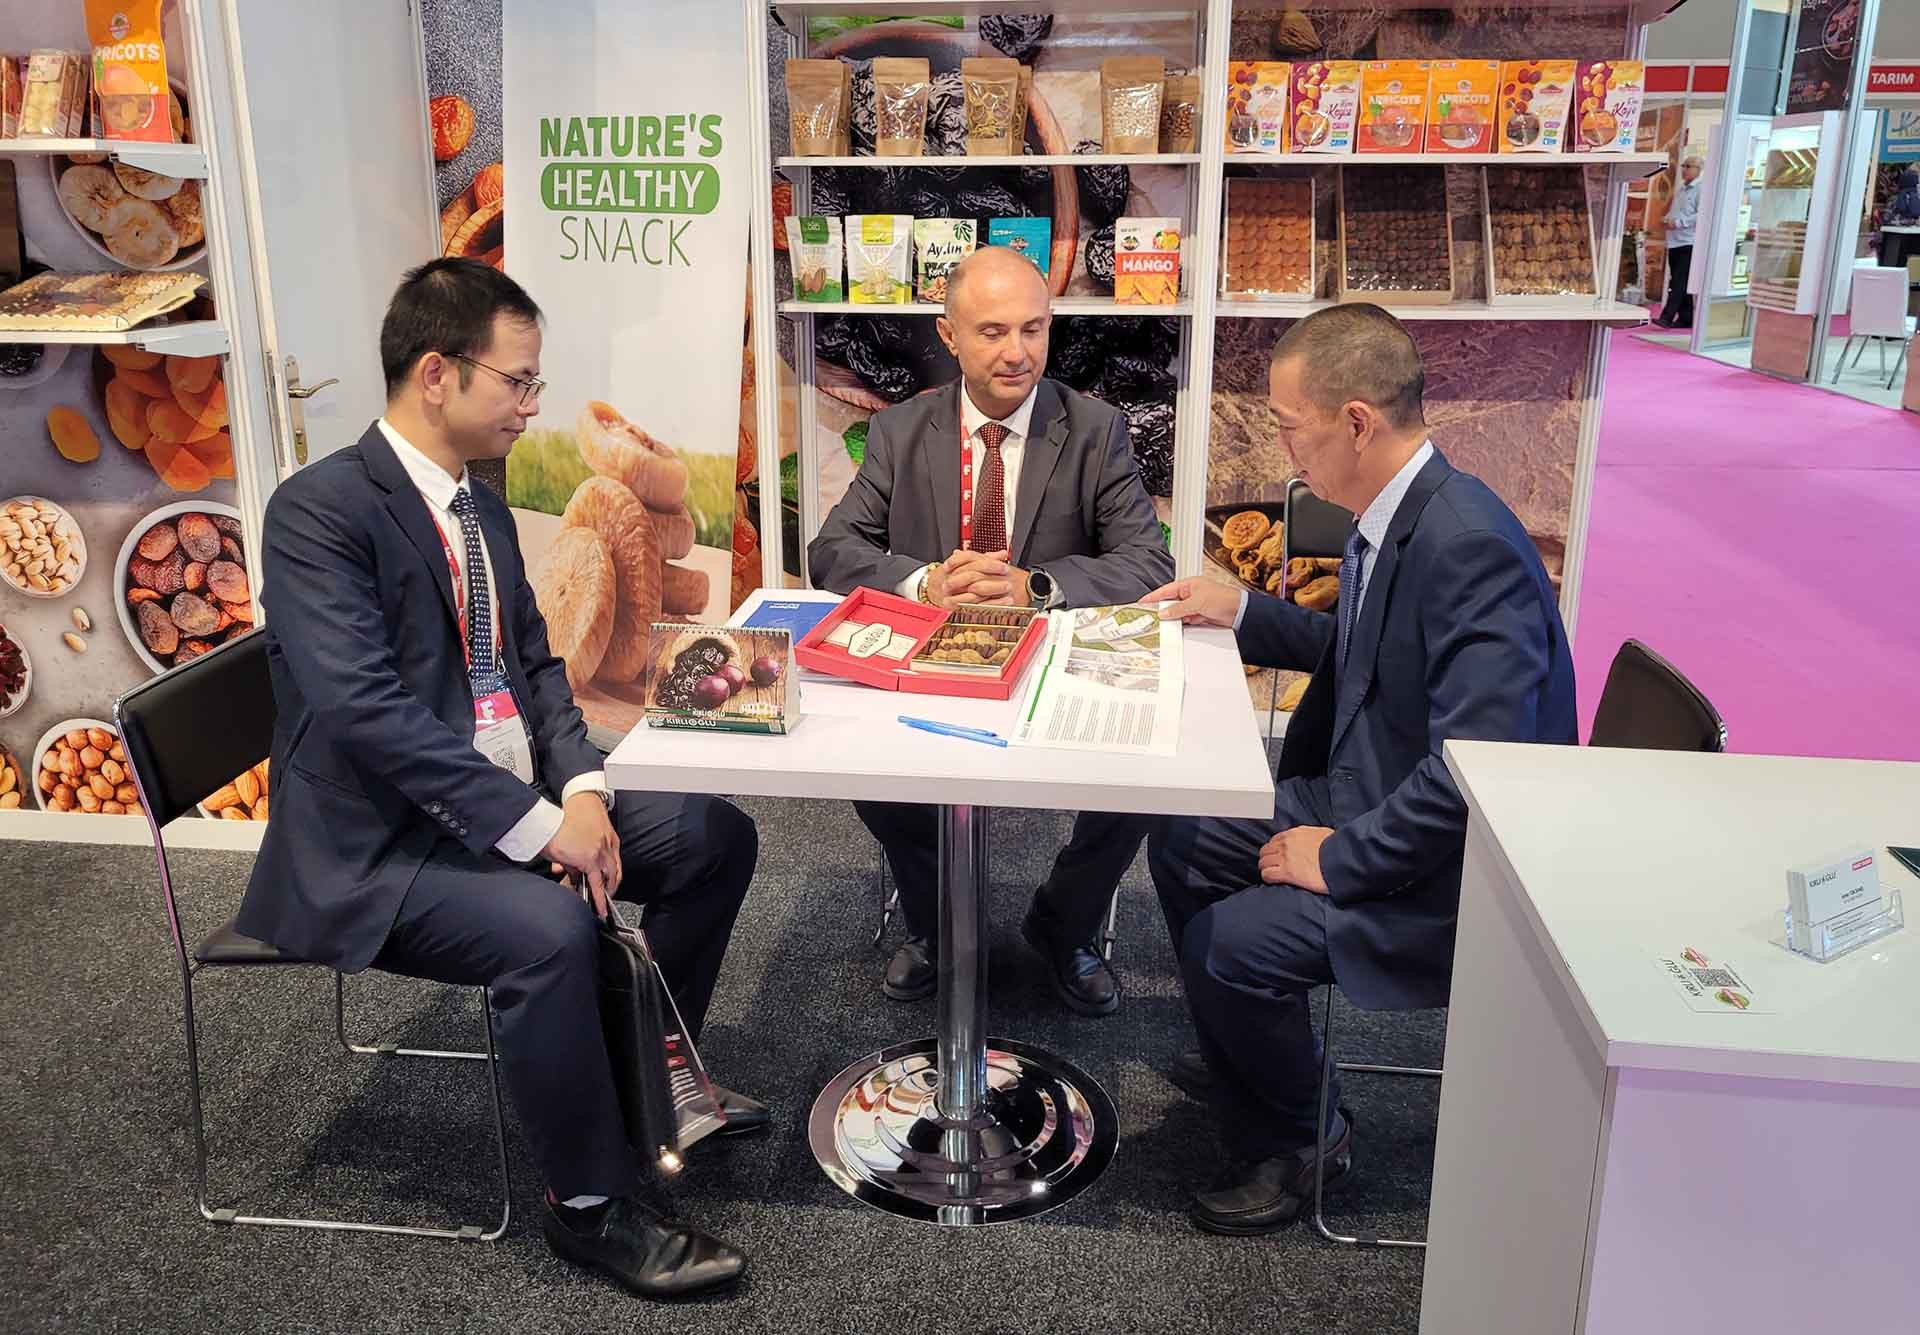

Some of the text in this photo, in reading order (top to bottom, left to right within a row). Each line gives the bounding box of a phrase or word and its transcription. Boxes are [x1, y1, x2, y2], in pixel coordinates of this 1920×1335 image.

[1871, 73, 1915, 85] TARIM
[540, 113, 722, 157] NATURE'S
[553, 168, 705, 209] HEALTHY
[559, 215, 693, 267] SNACK
[1122, 259, 1174, 273] MANGO
